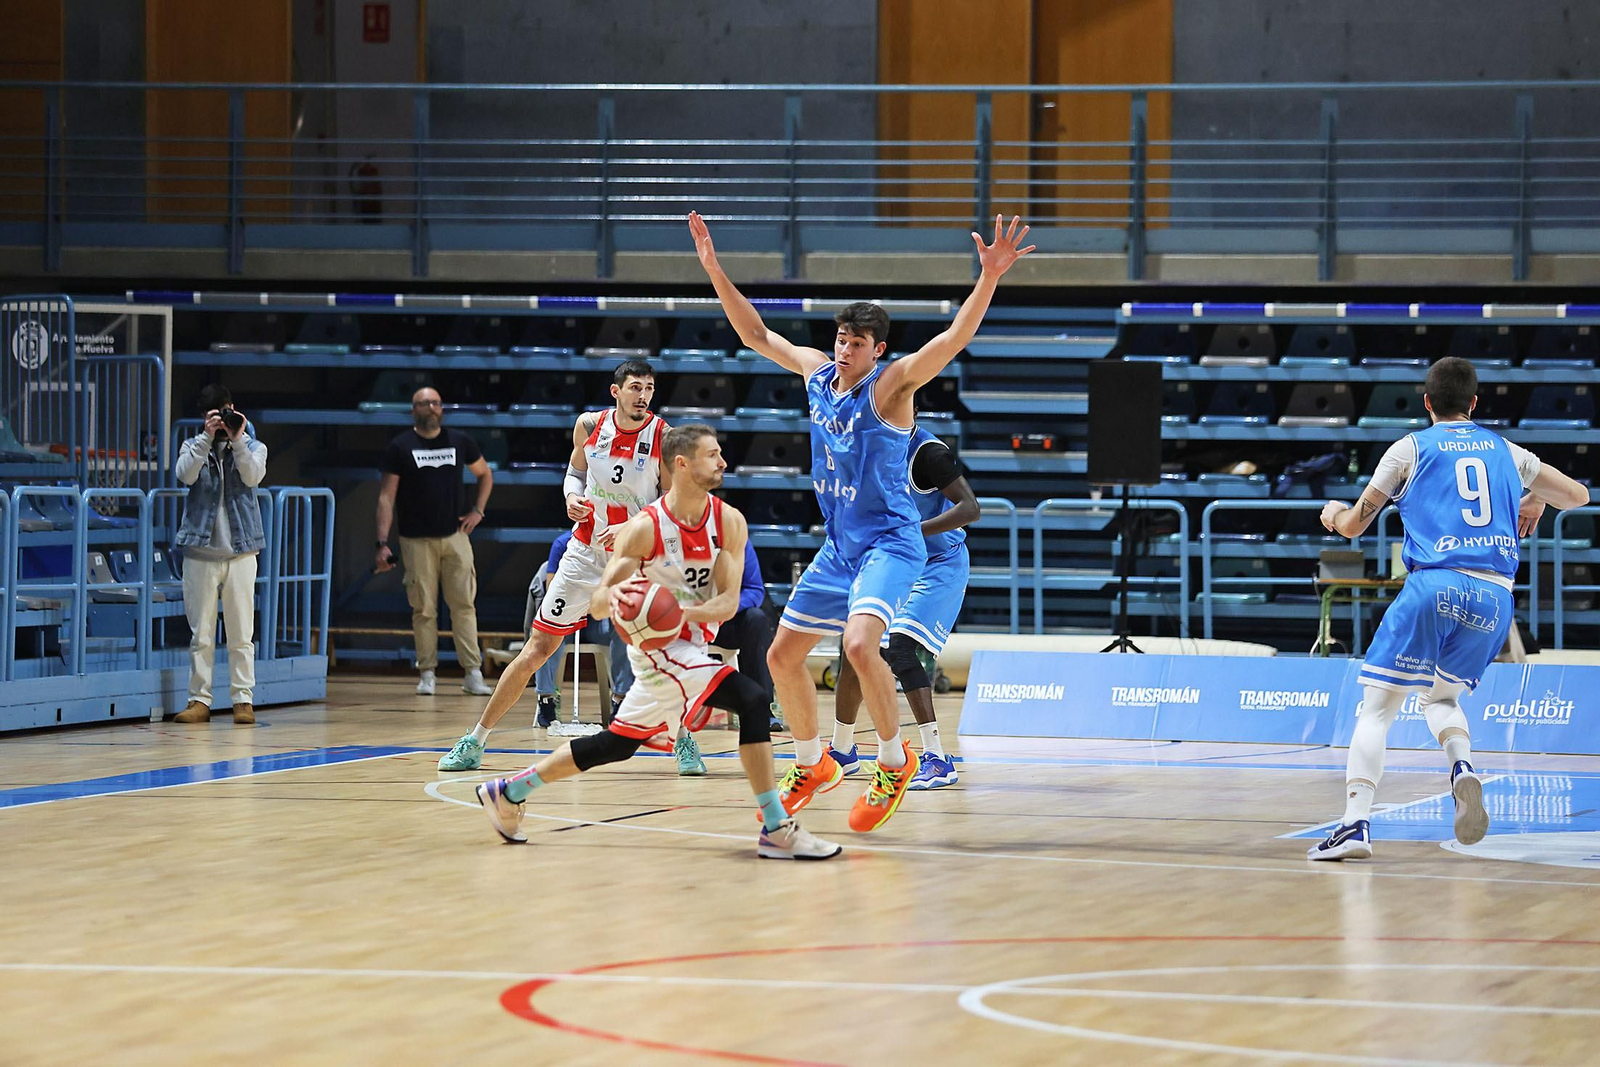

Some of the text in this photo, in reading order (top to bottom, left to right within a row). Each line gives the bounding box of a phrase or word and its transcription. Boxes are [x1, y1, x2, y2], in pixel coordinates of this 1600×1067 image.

[52, 333, 115, 344] Ayutamiento
[83, 345, 114, 354] Huelva
[1437, 440, 1495, 452] URDIAIN
[824, 443, 836, 471] 6
[611, 464, 625, 484] 3
[1455, 457, 1493, 528] 9
[1464, 535, 1517, 548] HYUNDA
[685, 567, 711, 589] 22
[551, 597, 567, 617] 3
[1438, 601, 1496, 632] GESTIA
[977, 683, 1065, 700] TRANSROMÁN
[1111, 686, 1200, 703] TRANSROMÁN
[1239, 690, 1330, 707] TRANSROMÁN
[1483, 699, 1575, 720] publibit
[1495, 717, 1528, 725] marketing
